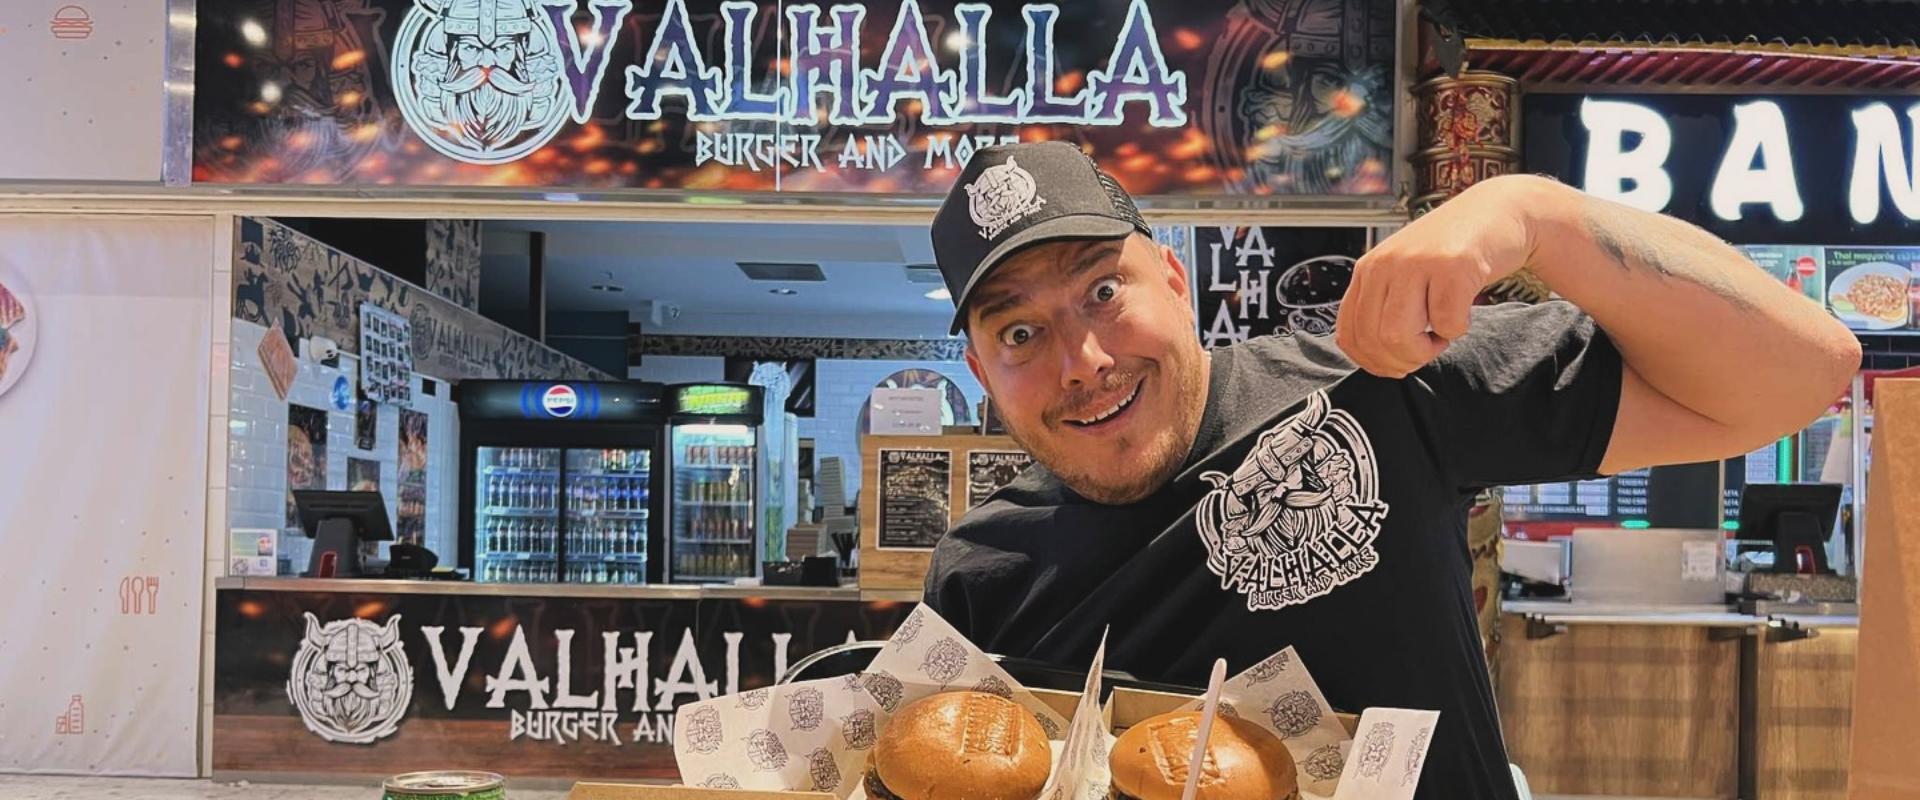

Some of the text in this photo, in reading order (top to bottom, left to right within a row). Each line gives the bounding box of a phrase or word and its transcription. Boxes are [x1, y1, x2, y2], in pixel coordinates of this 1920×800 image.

[535, 0, 1187, 126] VALHALLA
[695, 131, 1020, 172] BURGER AND MO
[1580, 97, 1920, 224] BAN
[1224, 502, 1386, 591] VALHALLA
[1251, 546, 1375, 606] BURGER AND MORE
[421, 625, 857, 711] VALHAL
[510, 709, 674, 746] BURGER AN
